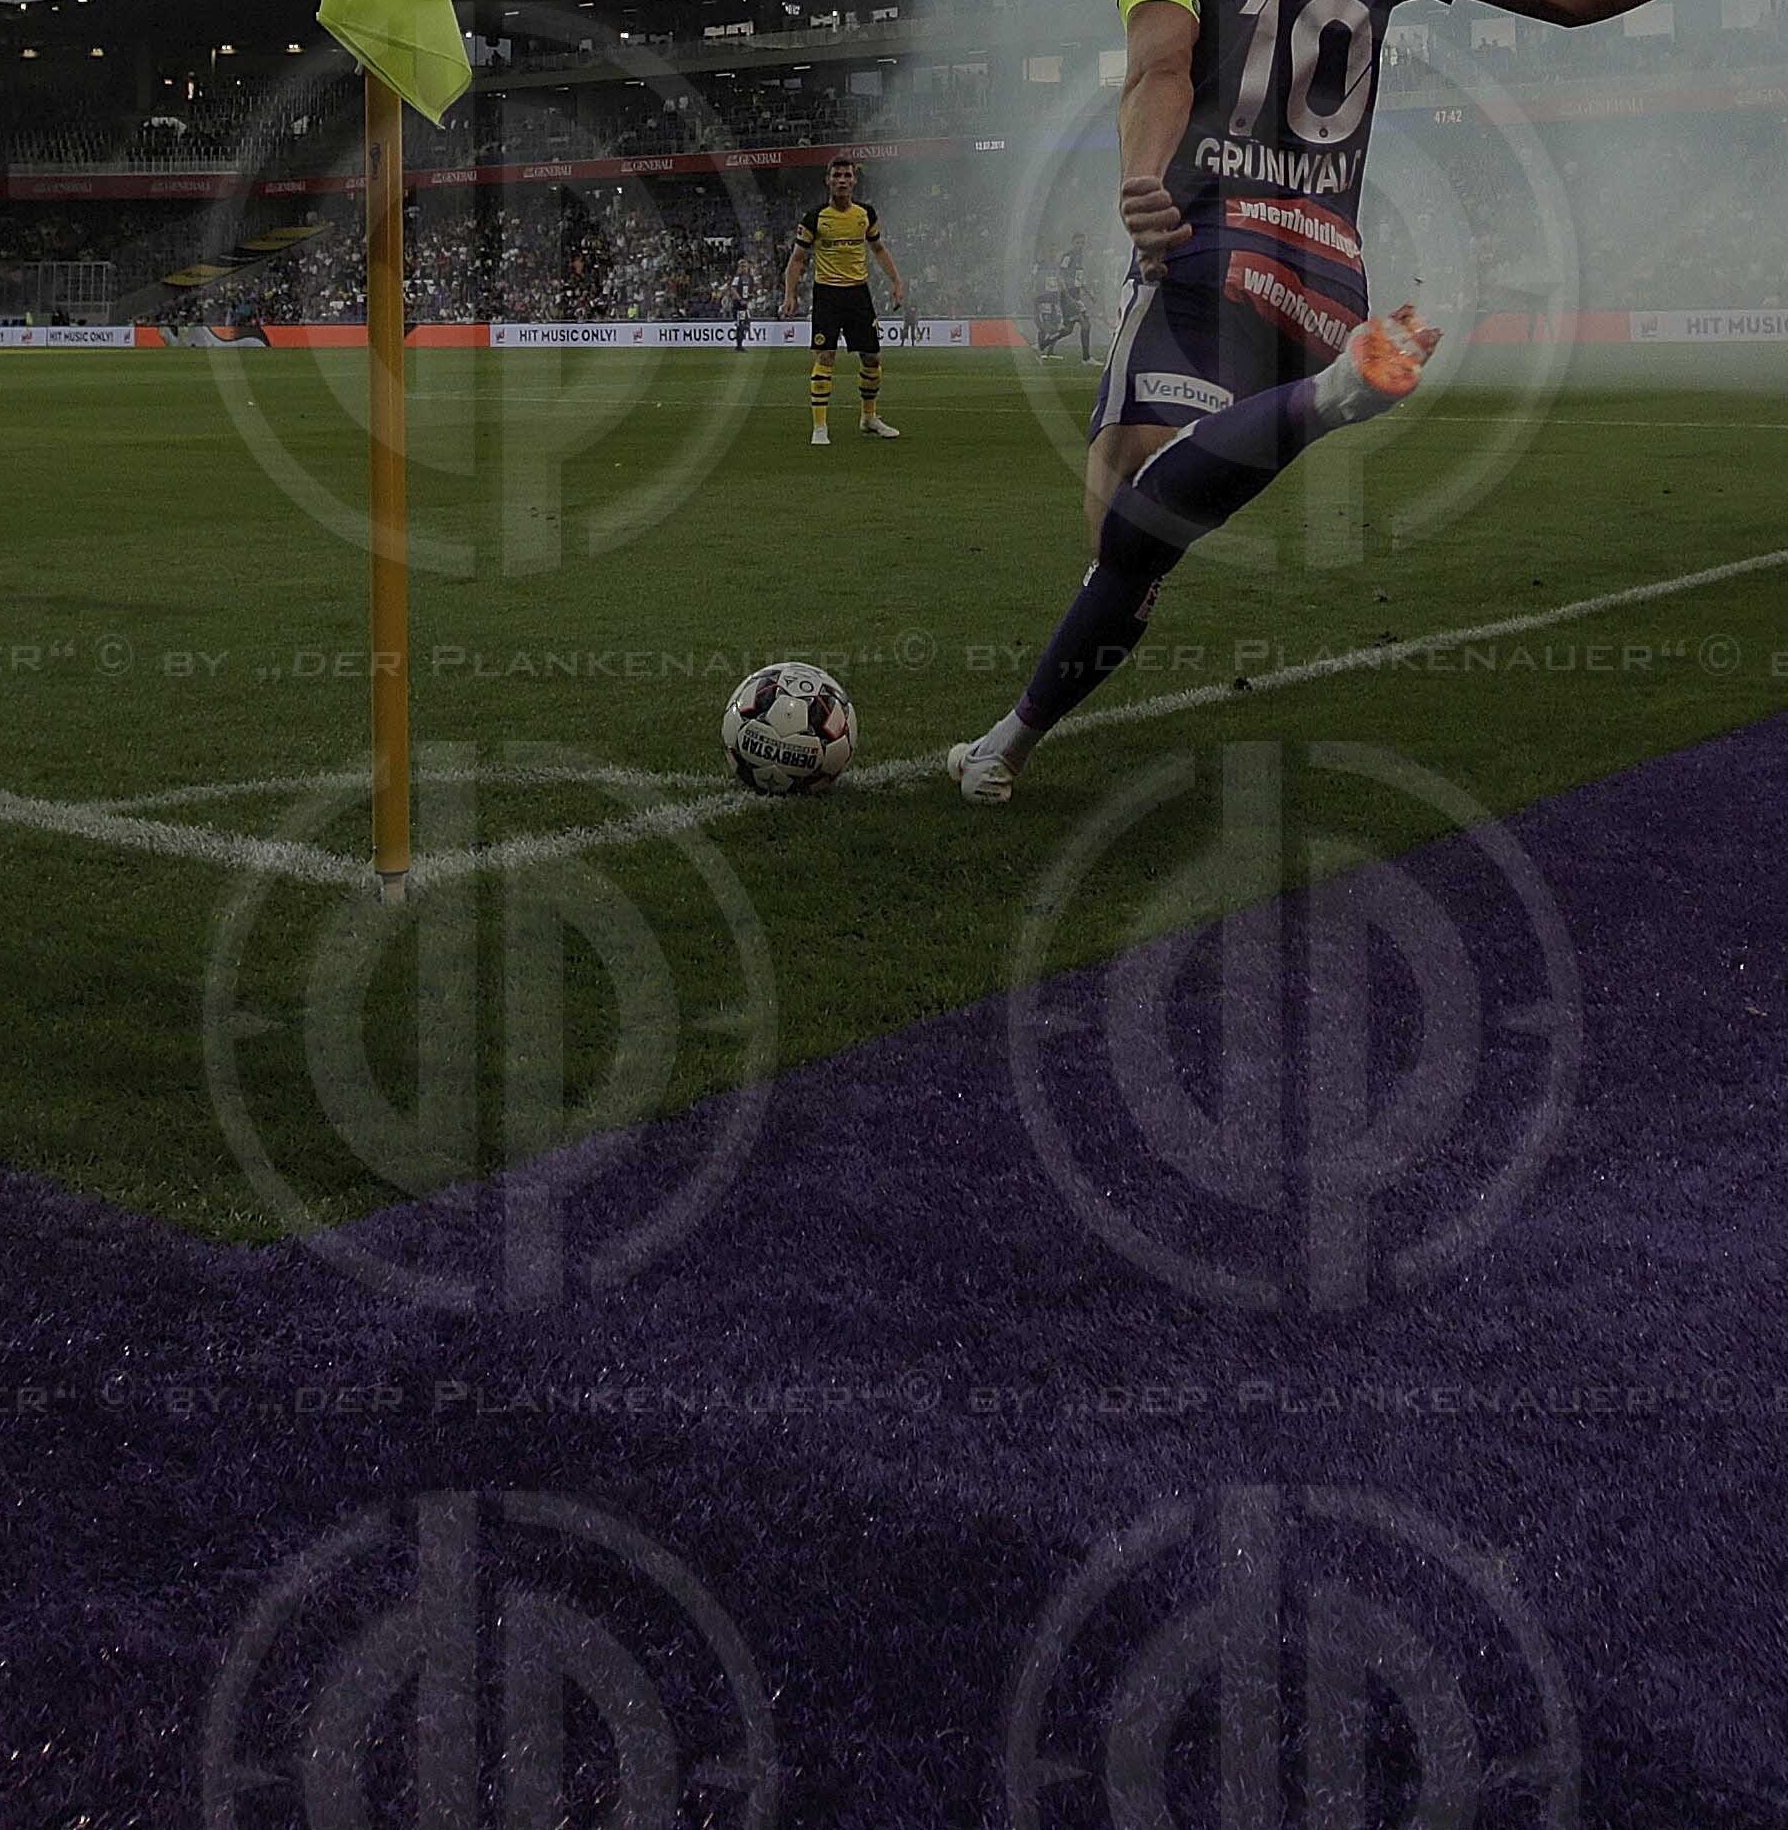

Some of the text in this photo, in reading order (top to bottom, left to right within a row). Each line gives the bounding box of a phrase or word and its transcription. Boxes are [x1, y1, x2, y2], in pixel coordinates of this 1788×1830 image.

[738, 152, 782, 165] GENERALI
[852, 145, 899, 159] GENERALI
[532, 166, 572, 178] GENERALI
[632, 159, 673, 172] GENERALI
[1687, 317, 1724, 334] HIT
[49, 332, 61, 342] HIT
[65, 332, 88, 342] MUSIC
[91, 332, 114, 342] ONLY!
[519, 329, 538, 341] HIT
[542, 329, 579, 341] MUSIC
[582, 329, 617, 341] ONLY!
[659, 328, 766, 341] HIT MUSIC OLY!
[742, 735, 819, 769] DERBYSTAR
